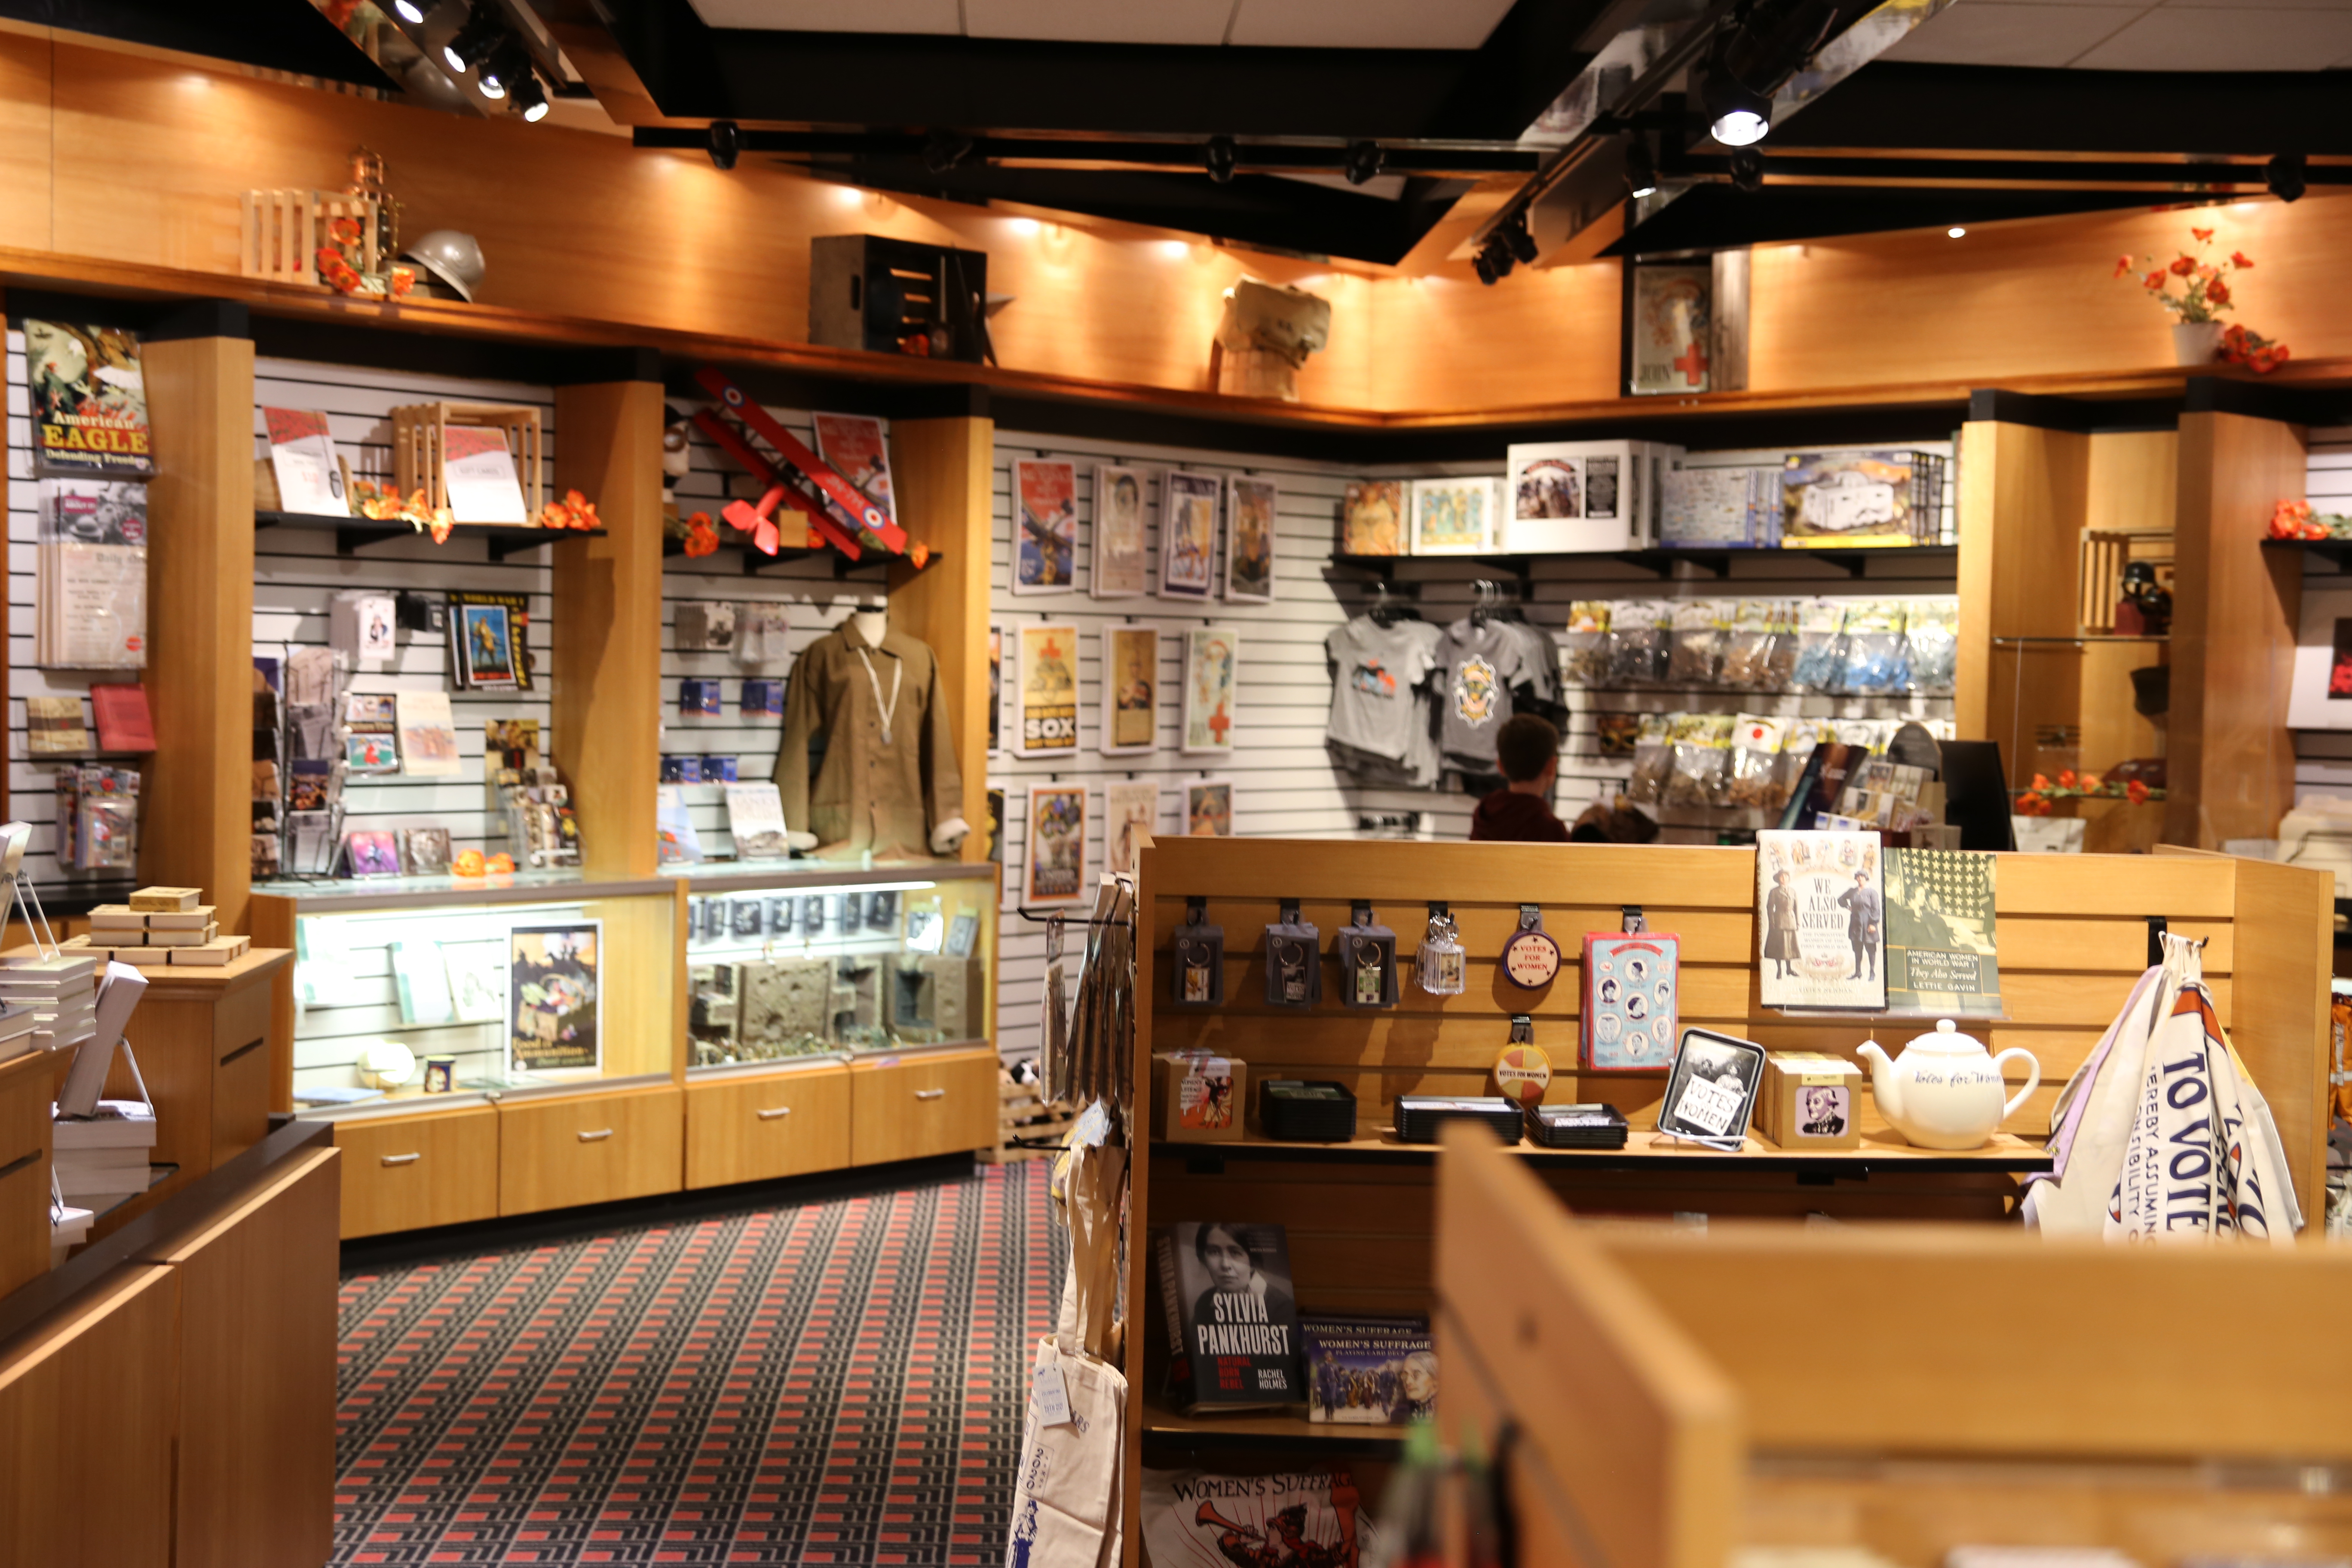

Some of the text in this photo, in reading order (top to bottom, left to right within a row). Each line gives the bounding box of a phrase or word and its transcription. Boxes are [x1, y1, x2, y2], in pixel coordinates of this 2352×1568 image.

[52, 410, 135, 429] American
[42, 424, 149, 453] EAGLE
[46, 449, 102, 463] Defending
[462, 592, 494, 603] WORLD
[497, 594, 518, 606] WAR
[1025, 718, 1075, 739] SOX
[1813, 877, 1831, 894] WE
[1809, 895, 1837, 912] ALSO
[1802, 912, 1844, 930] SERVED
[1907, 949, 1978, 962] AMERICAN WOMEN
[1921, 958, 1950, 967] WORLD
[1951, 960, 1969, 968] WAR
[1971, 961, 1975, 969] I
[1911, 966, 1977, 981] They Also Served
[1913, 981, 1975, 992] LETTIE GAVIN
[1915, 1070, 1943, 1084] Votes
[1950, 1072, 1973, 1088] for
[2162, 1051, 2208, 1109] TO
[1690, 1080, 1737, 1113] VOTES
[1678, 1099, 1728, 1130] WOMEN
[2167, 1112, 2211, 1232] VOTE
[1157, 1236, 1175, 1280] SYLVIA
[1213, 1292, 1269, 1323] SYLVIA
[1162, 1280, 1184, 1356] PANKHURST
[1303, 1323, 1413, 1335] WOMEN'S SUFFRAGE
[1197, 1324, 1290, 1355] PANKHURST
[1318, 1339, 1432, 1350] WOMEN'S SUFFRAGE
[1217, 1356, 1252, 1367] NATURAL
[1218, 1367, 1240, 1378] BORN
[1257, 1369, 1284, 1379] RACHEL
[1220, 1378, 1244, 1390] REBEL
[1259, 1378, 1288, 1390] HOLMES
[1026, 1446, 1044, 1490] 2020
[1172, 1473, 1354, 1503] WOMEN'S SUFFRAG
